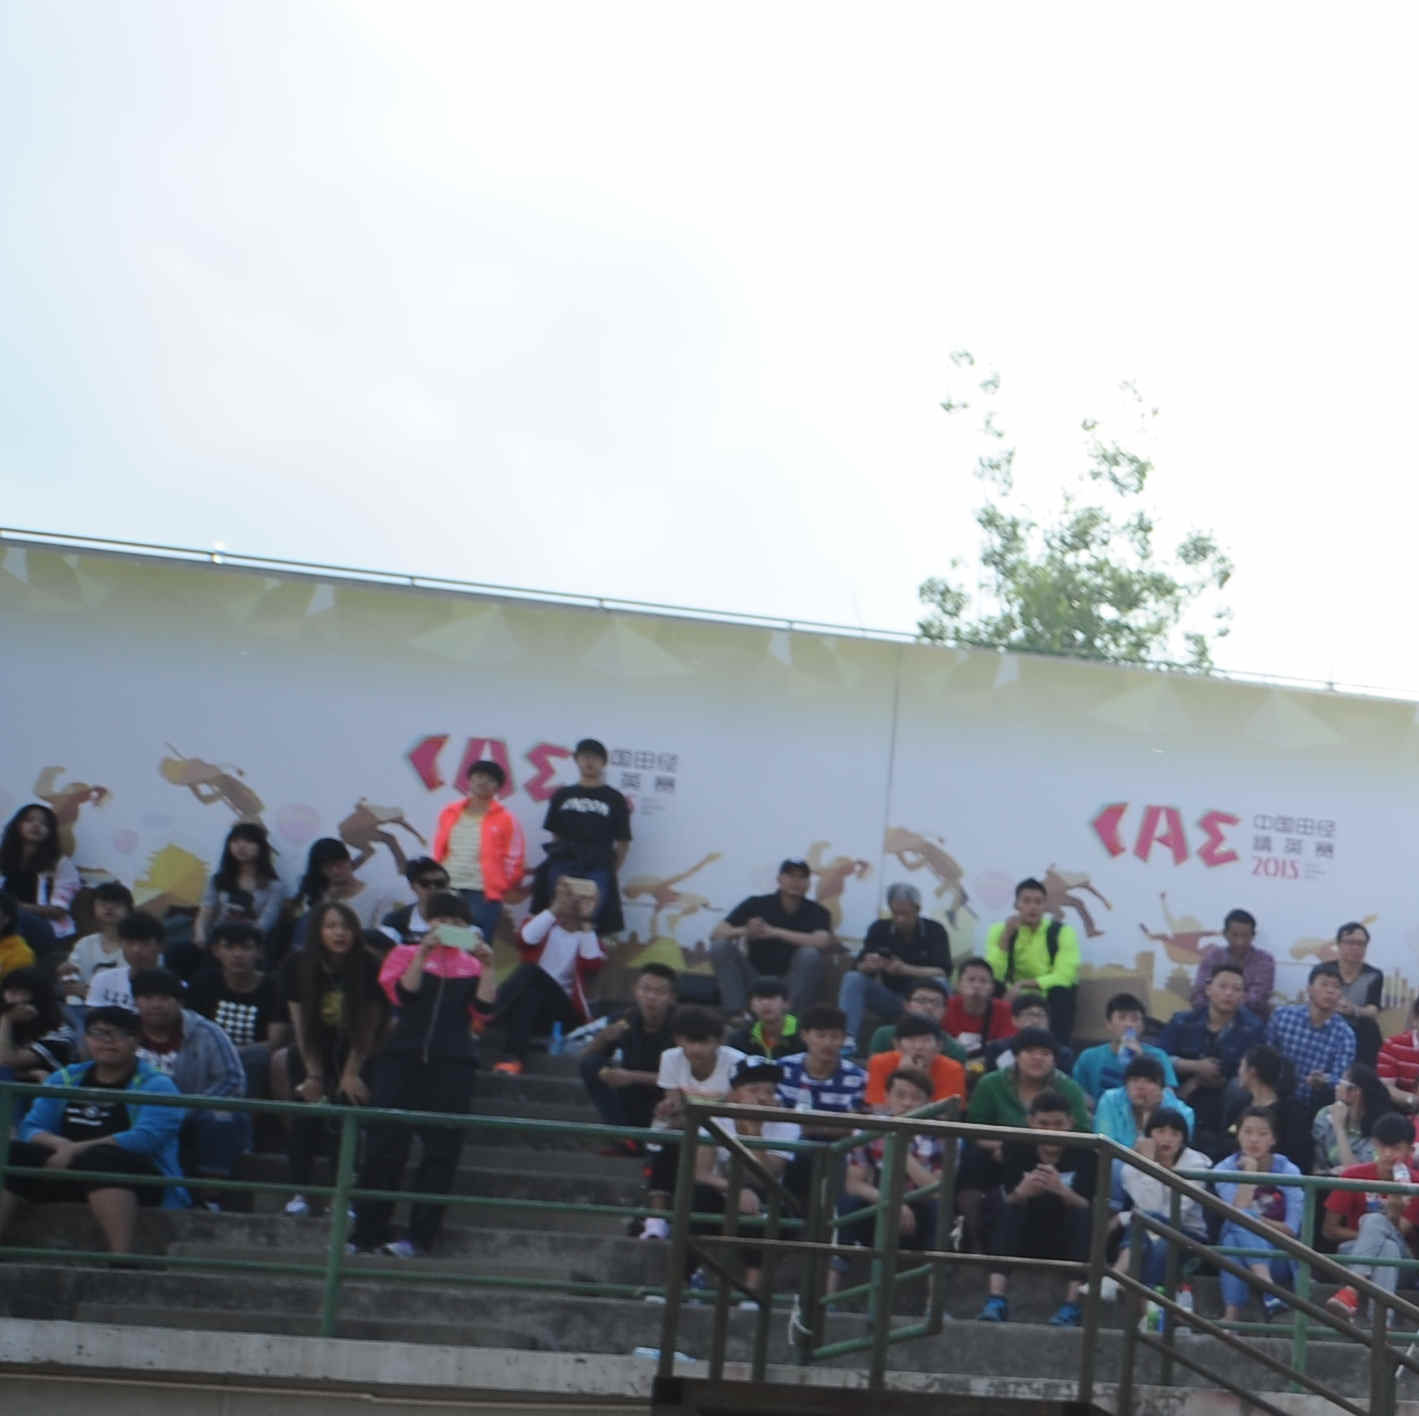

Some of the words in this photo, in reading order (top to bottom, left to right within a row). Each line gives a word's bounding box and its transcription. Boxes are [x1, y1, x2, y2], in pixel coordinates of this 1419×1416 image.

[1252, 813, 1337, 838] 中国田径
[1252, 836, 1335, 859] 精英赛
[1252, 856, 1299, 880] 2015
